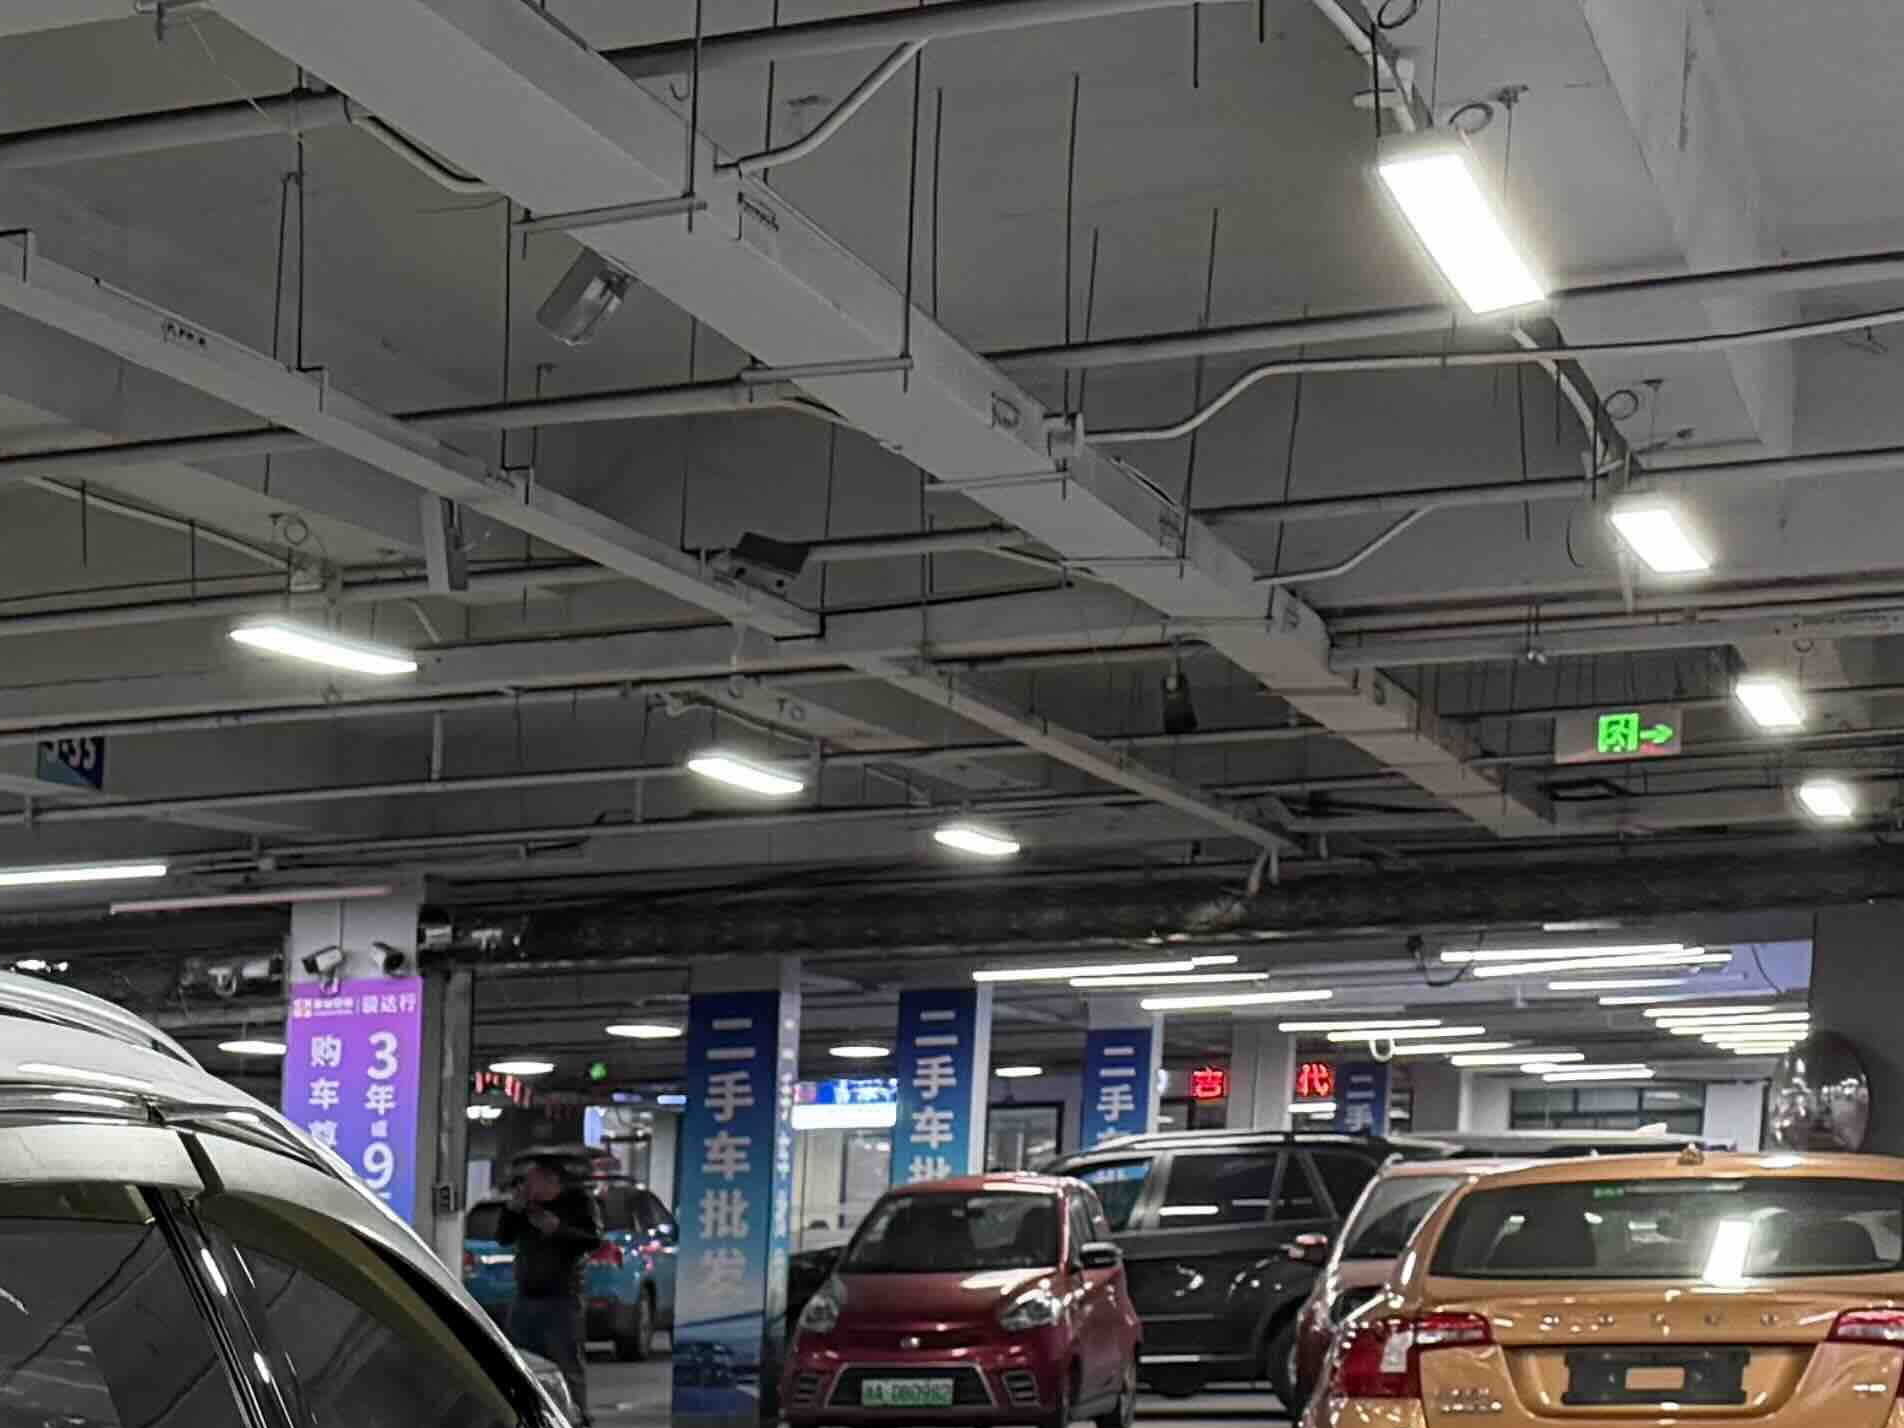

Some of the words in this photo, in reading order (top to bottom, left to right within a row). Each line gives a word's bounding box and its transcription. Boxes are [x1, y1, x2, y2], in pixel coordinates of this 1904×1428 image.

[700, 1016, 756, 1299] 二手车批发
